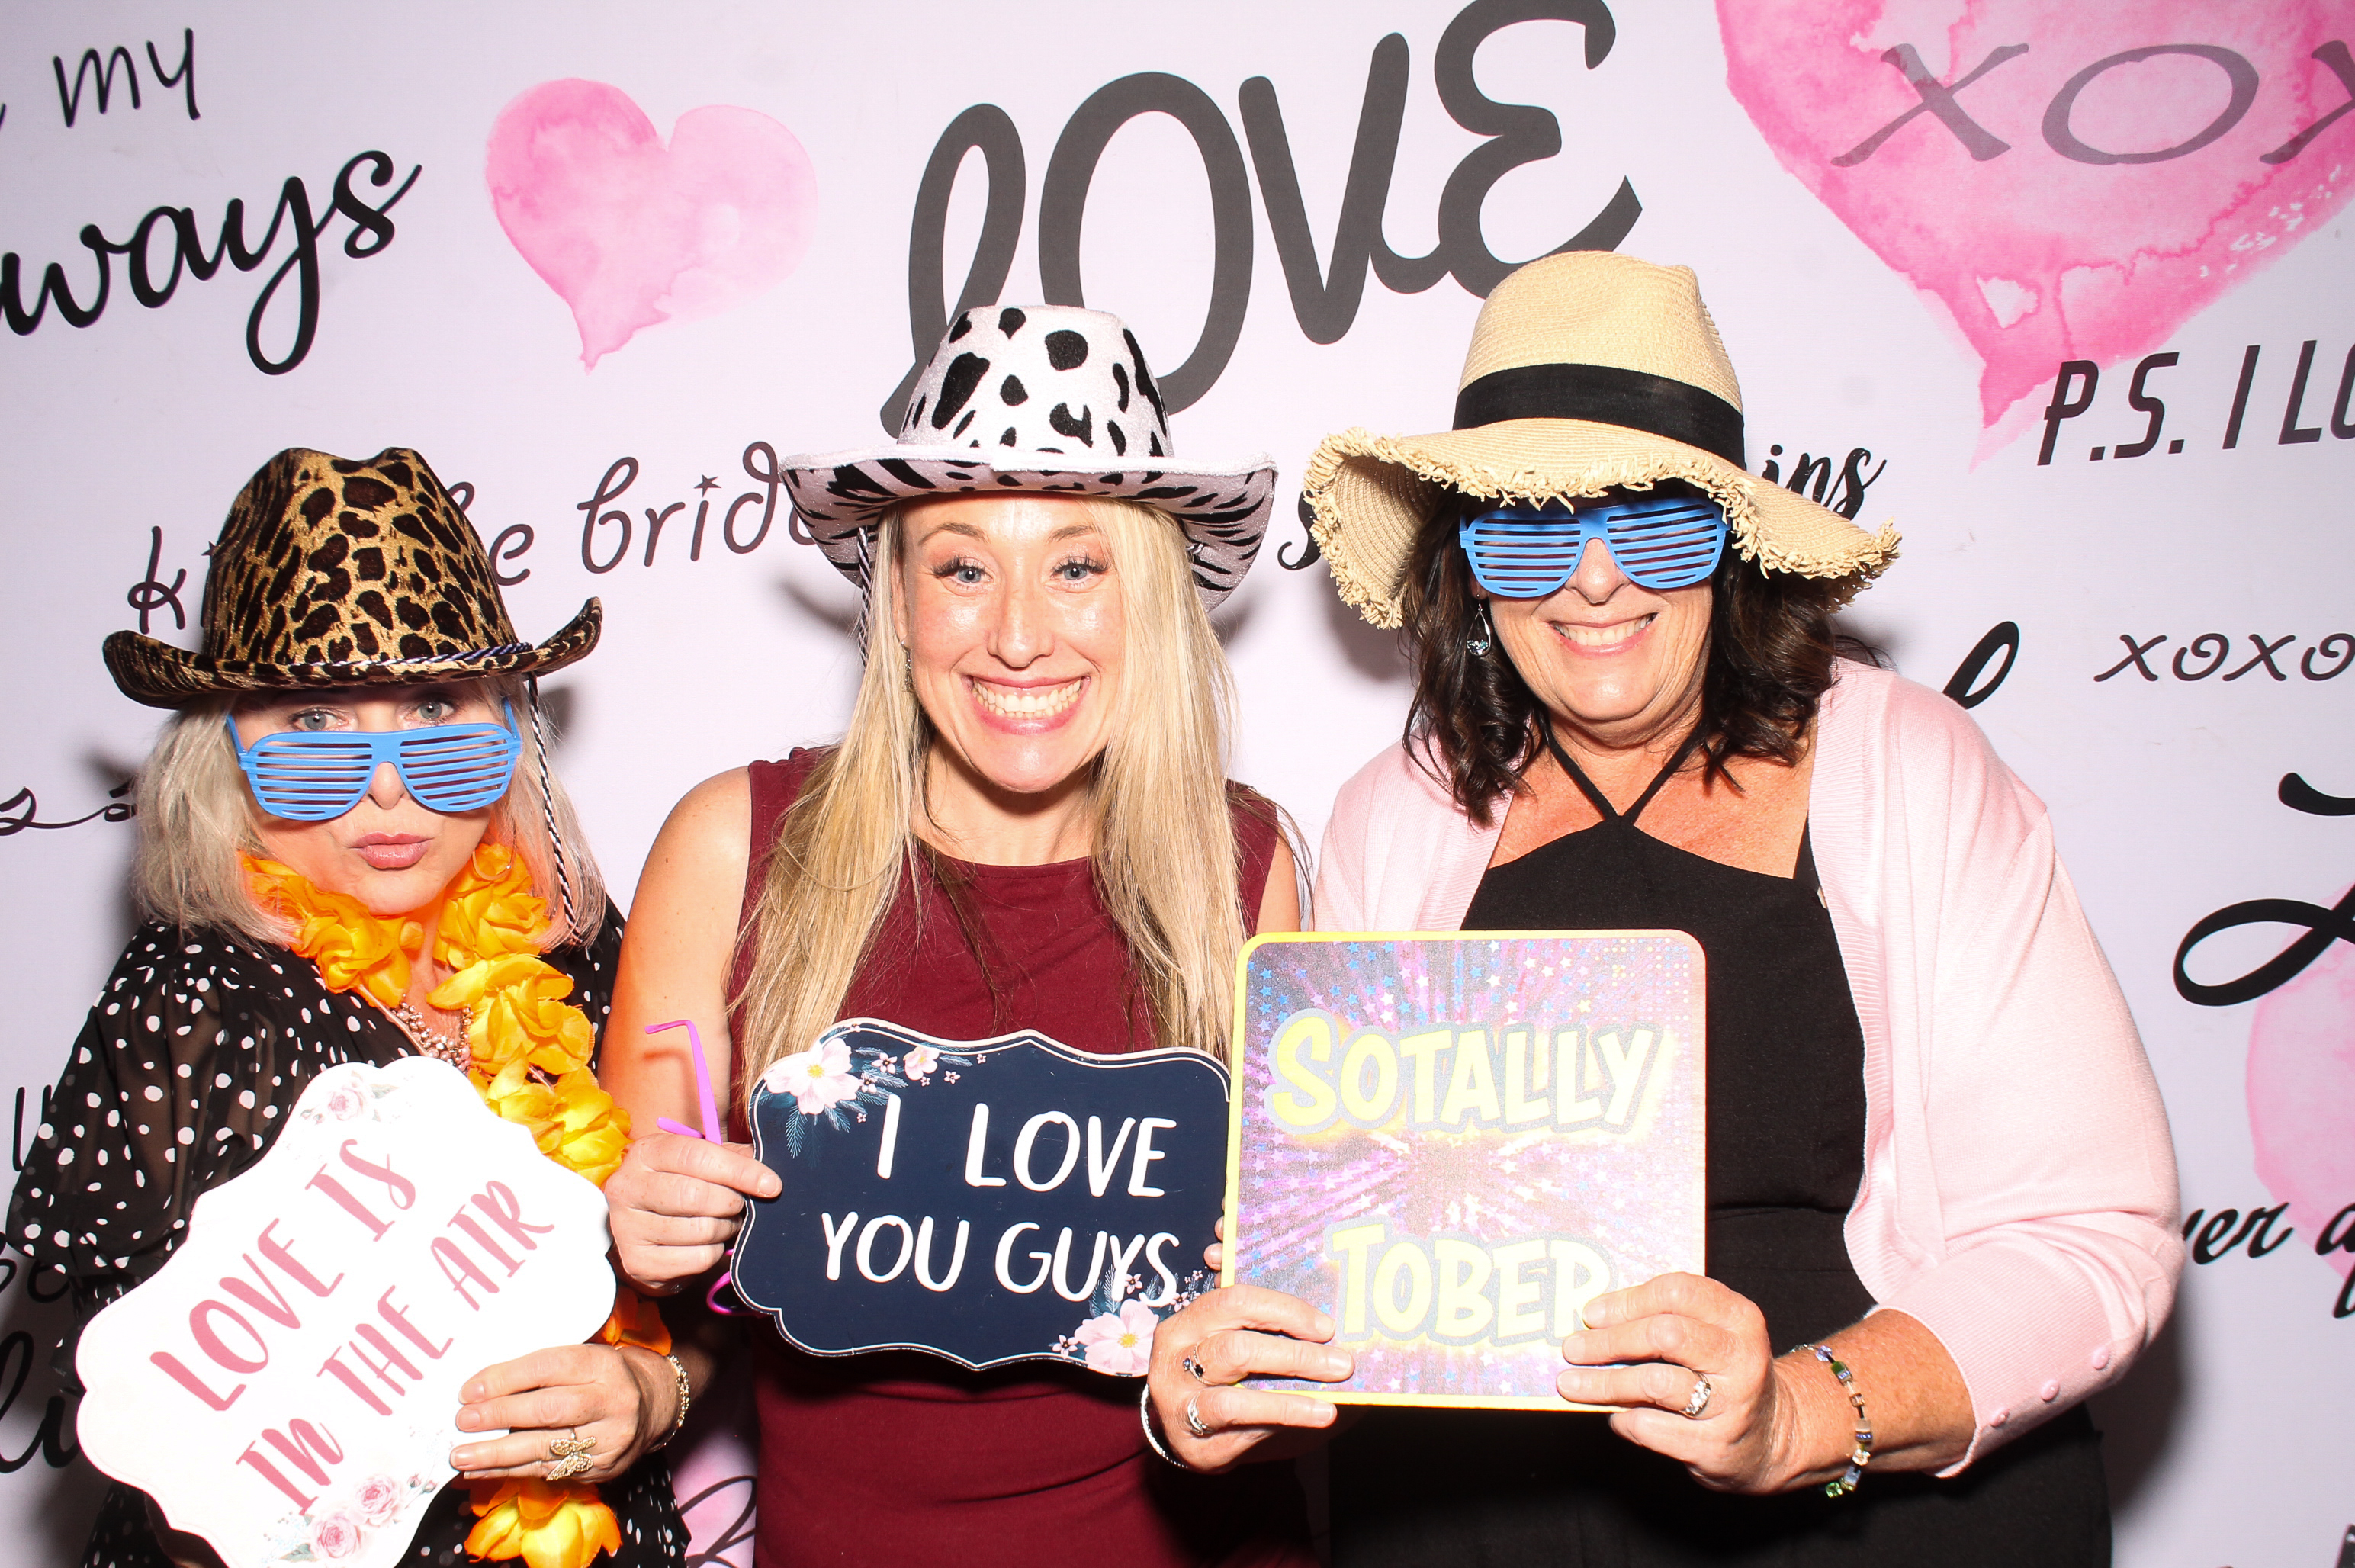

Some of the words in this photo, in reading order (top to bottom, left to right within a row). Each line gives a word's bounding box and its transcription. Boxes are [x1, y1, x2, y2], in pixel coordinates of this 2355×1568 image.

[2037, 351, 2186, 466] P.S.
[2222, 343, 2262, 450] I
[1264, 1008, 1664, 1136] SOTALLY
[876, 1094, 901, 1179] I
[964, 1102, 1178, 1197] LOVE
[150, 1218, 344, 1412] LOVE
[316, 1285, 455, 1416] THE
[430, 1181, 554, 1311] AIR
[821, 1211, 970, 1292] YOU
[994, 1222, 1181, 1308] GUYS
[1324, 1219, 1618, 1347] TOBER
